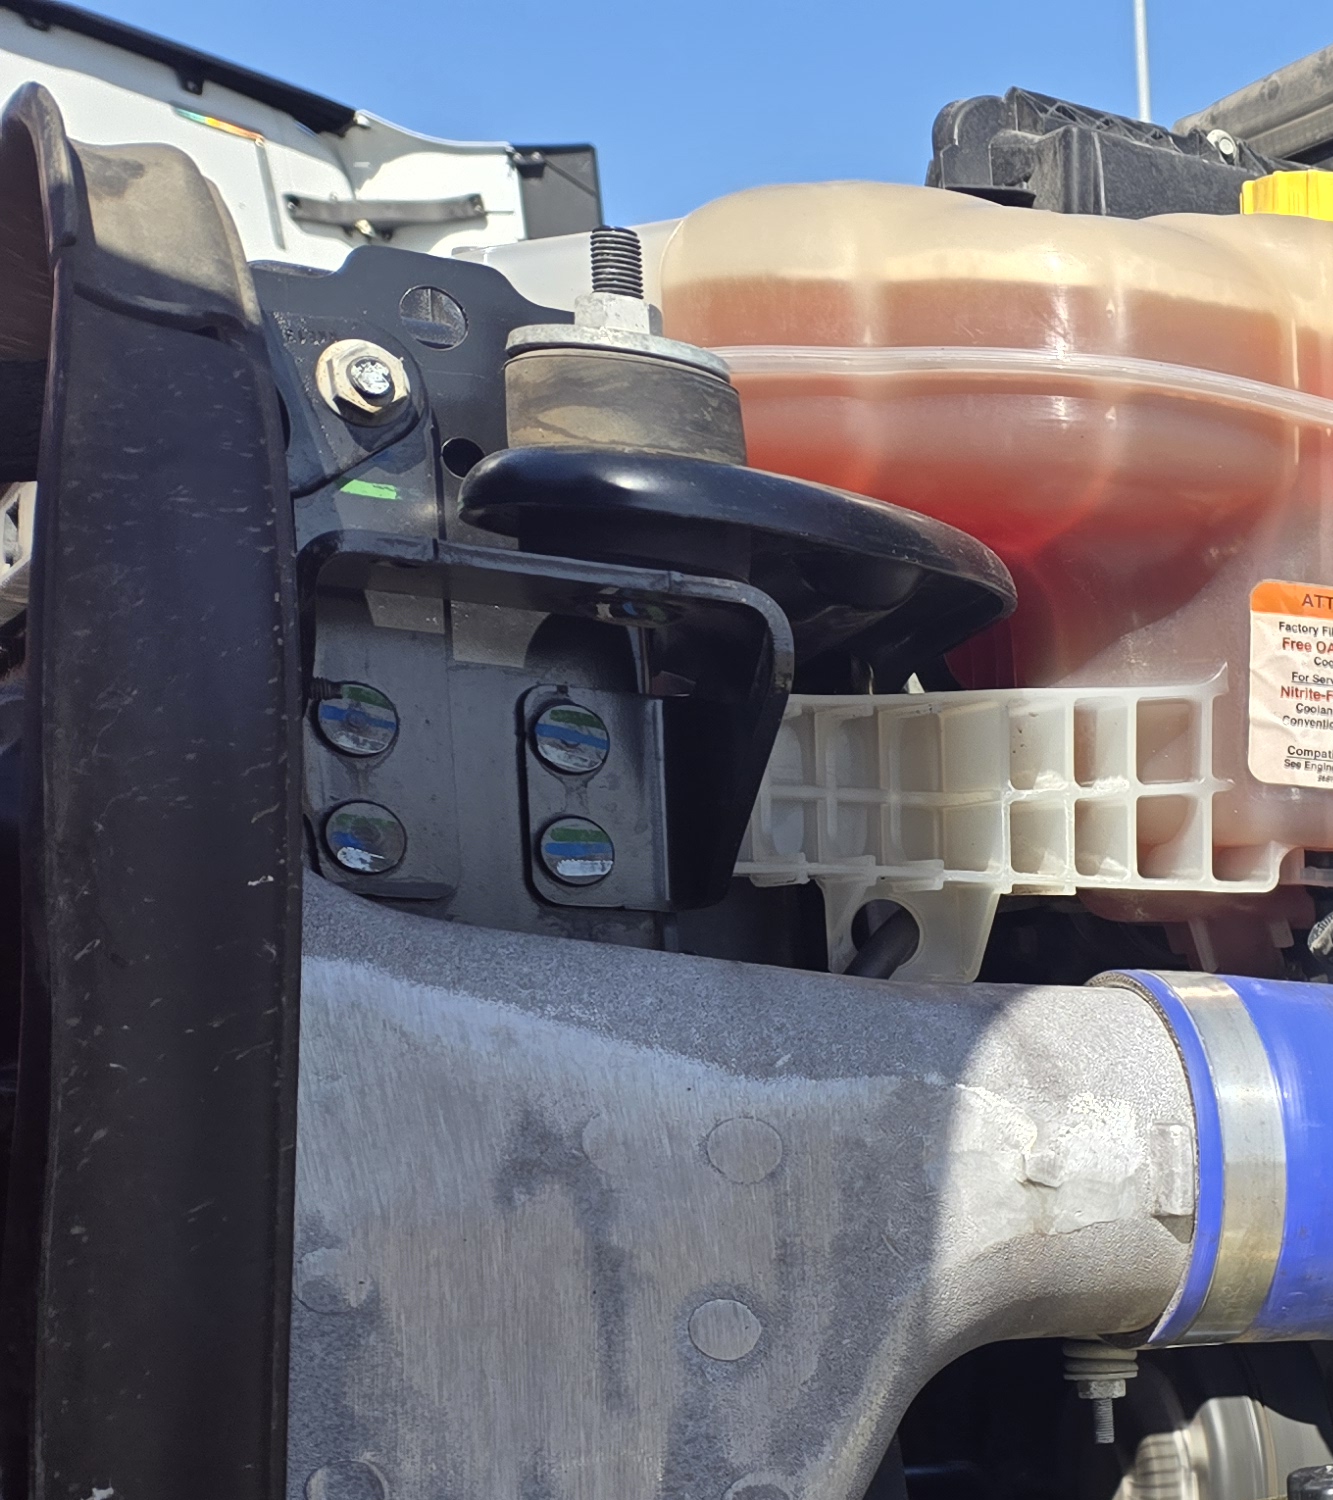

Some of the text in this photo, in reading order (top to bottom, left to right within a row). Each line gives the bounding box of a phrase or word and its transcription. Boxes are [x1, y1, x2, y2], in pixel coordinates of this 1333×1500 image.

[1278, 621, 1319, 638] Factory
[1282, 637, 1312, 652] Free
[1292, 671, 1309, 683] For
[1284, 758, 1302, 769] See
